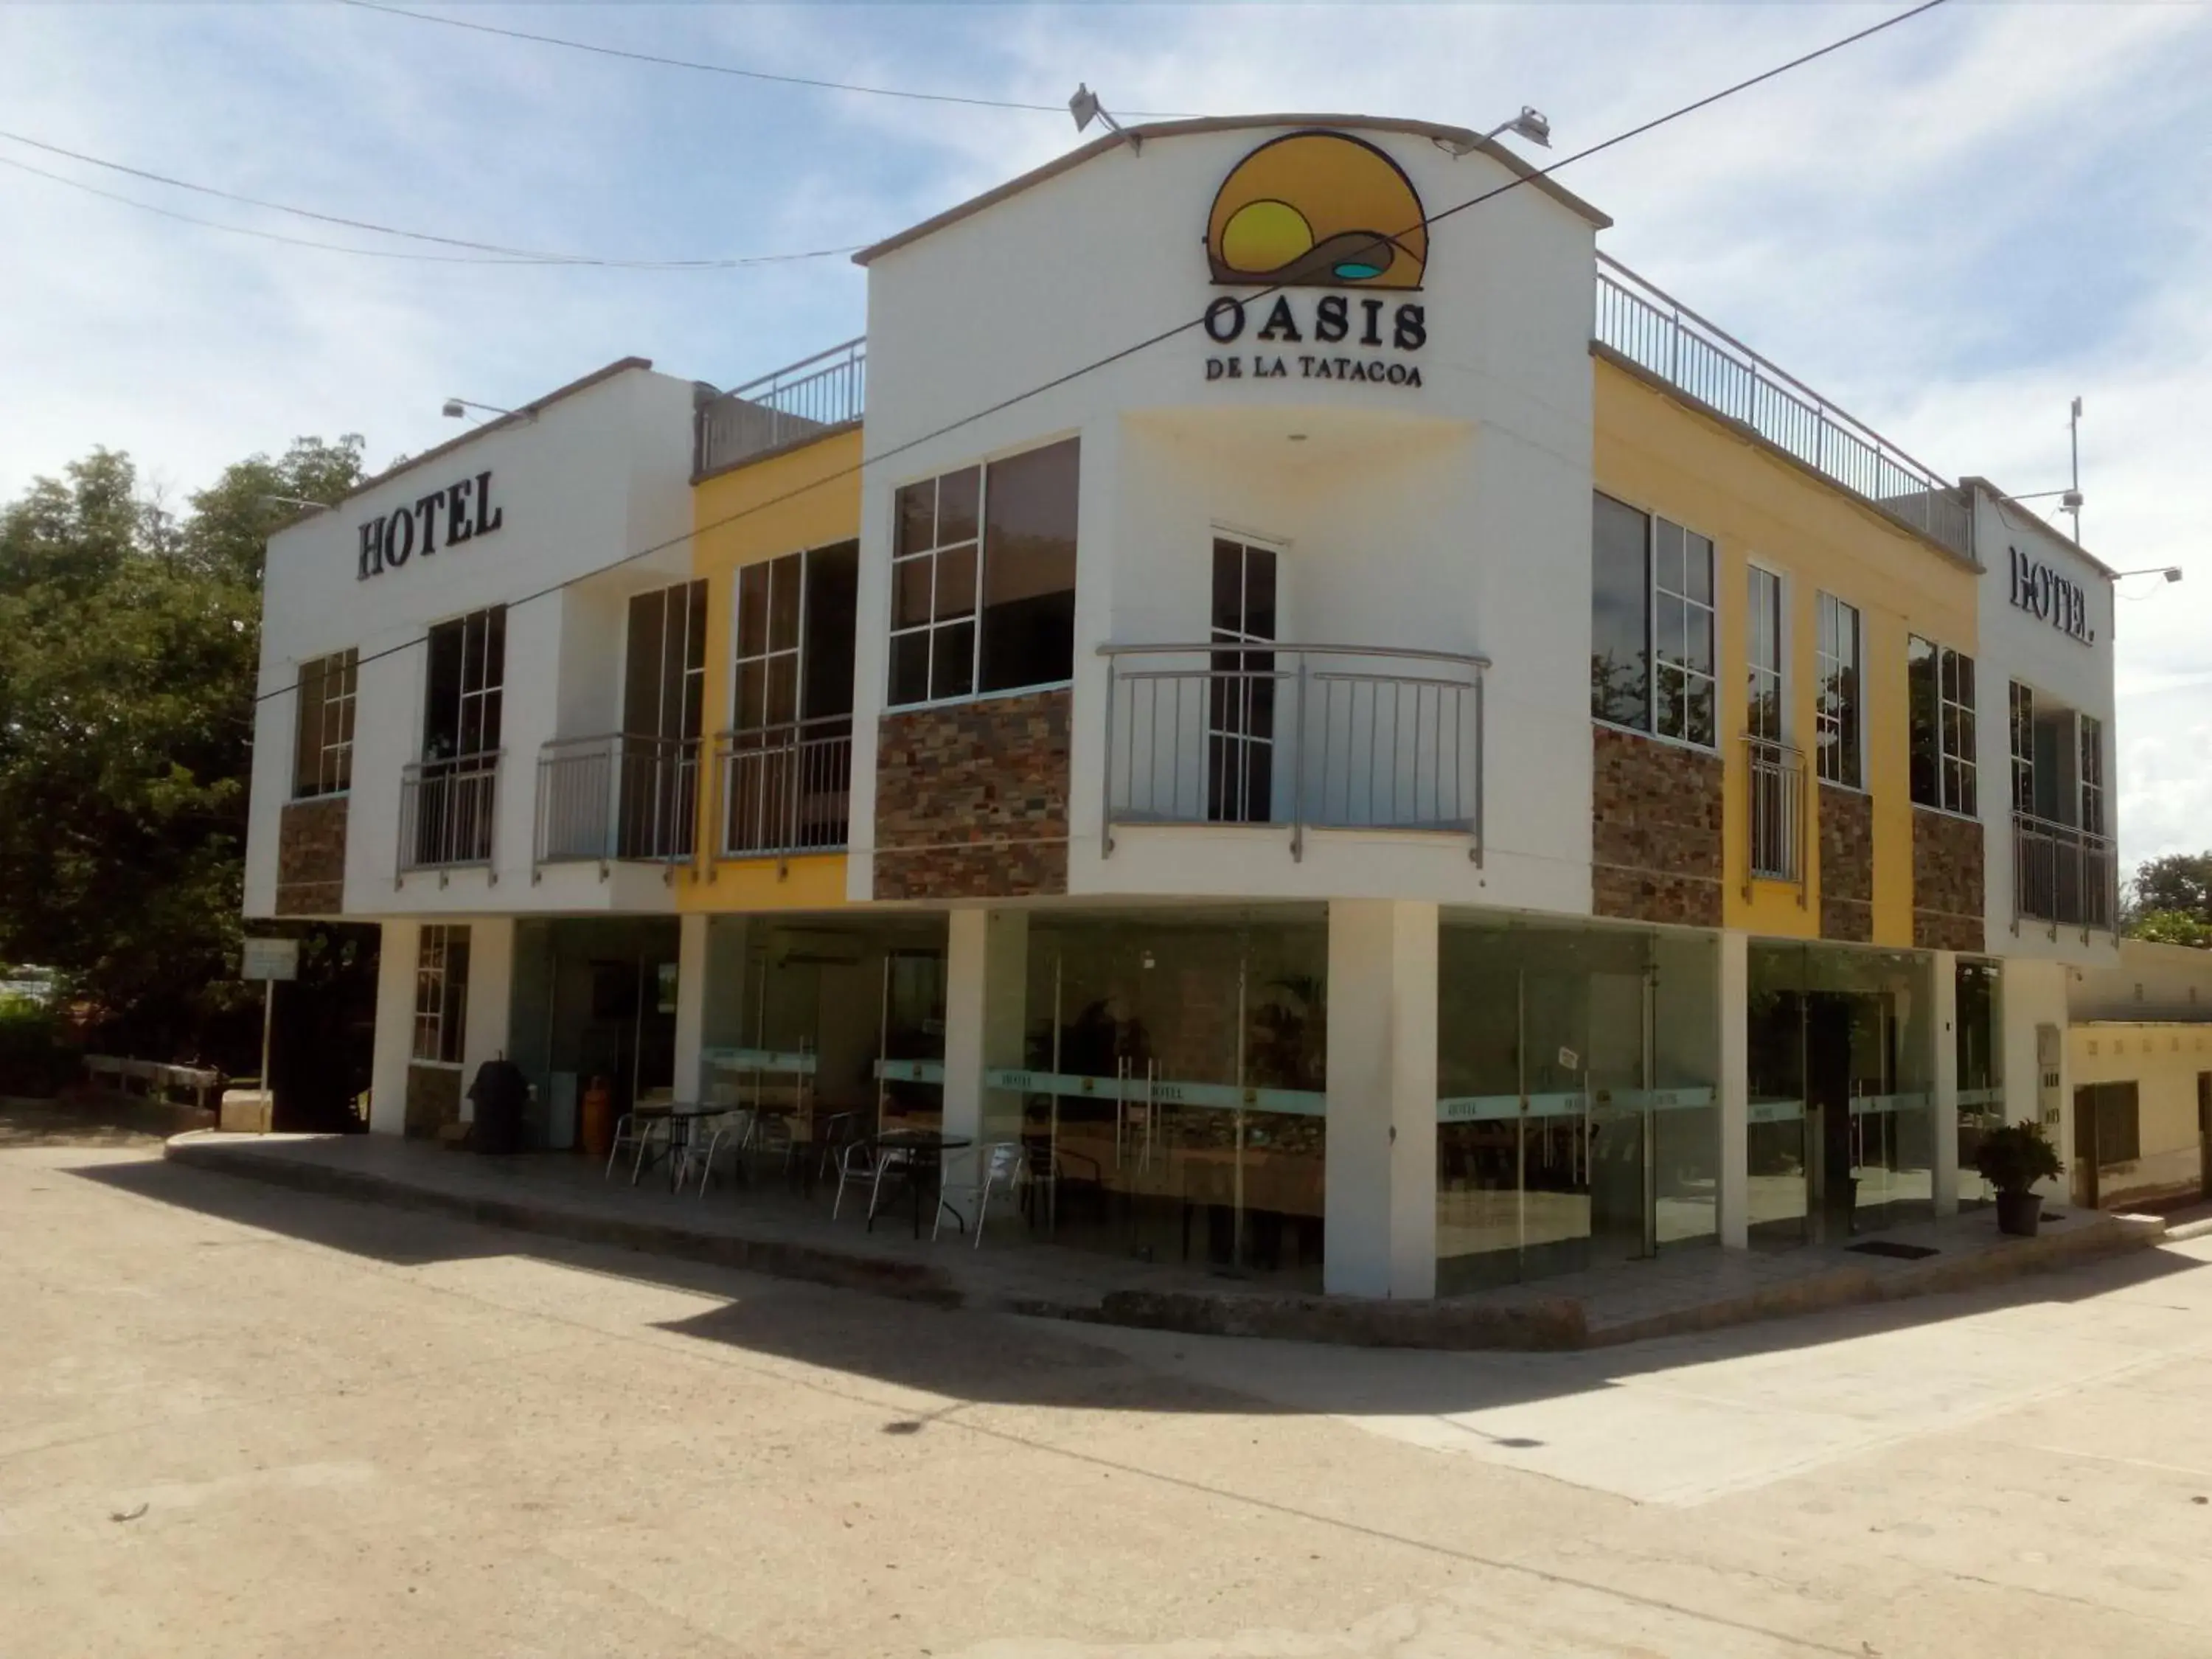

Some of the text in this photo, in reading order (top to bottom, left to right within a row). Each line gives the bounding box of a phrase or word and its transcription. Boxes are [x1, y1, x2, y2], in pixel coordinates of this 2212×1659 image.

[1204, 295, 1427, 350] OASIS
[1206, 356, 1422, 388] DE LA TATACOA
[357, 470, 503, 582] HOTEL
[2008, 545, 2094, 648] HOTEL
